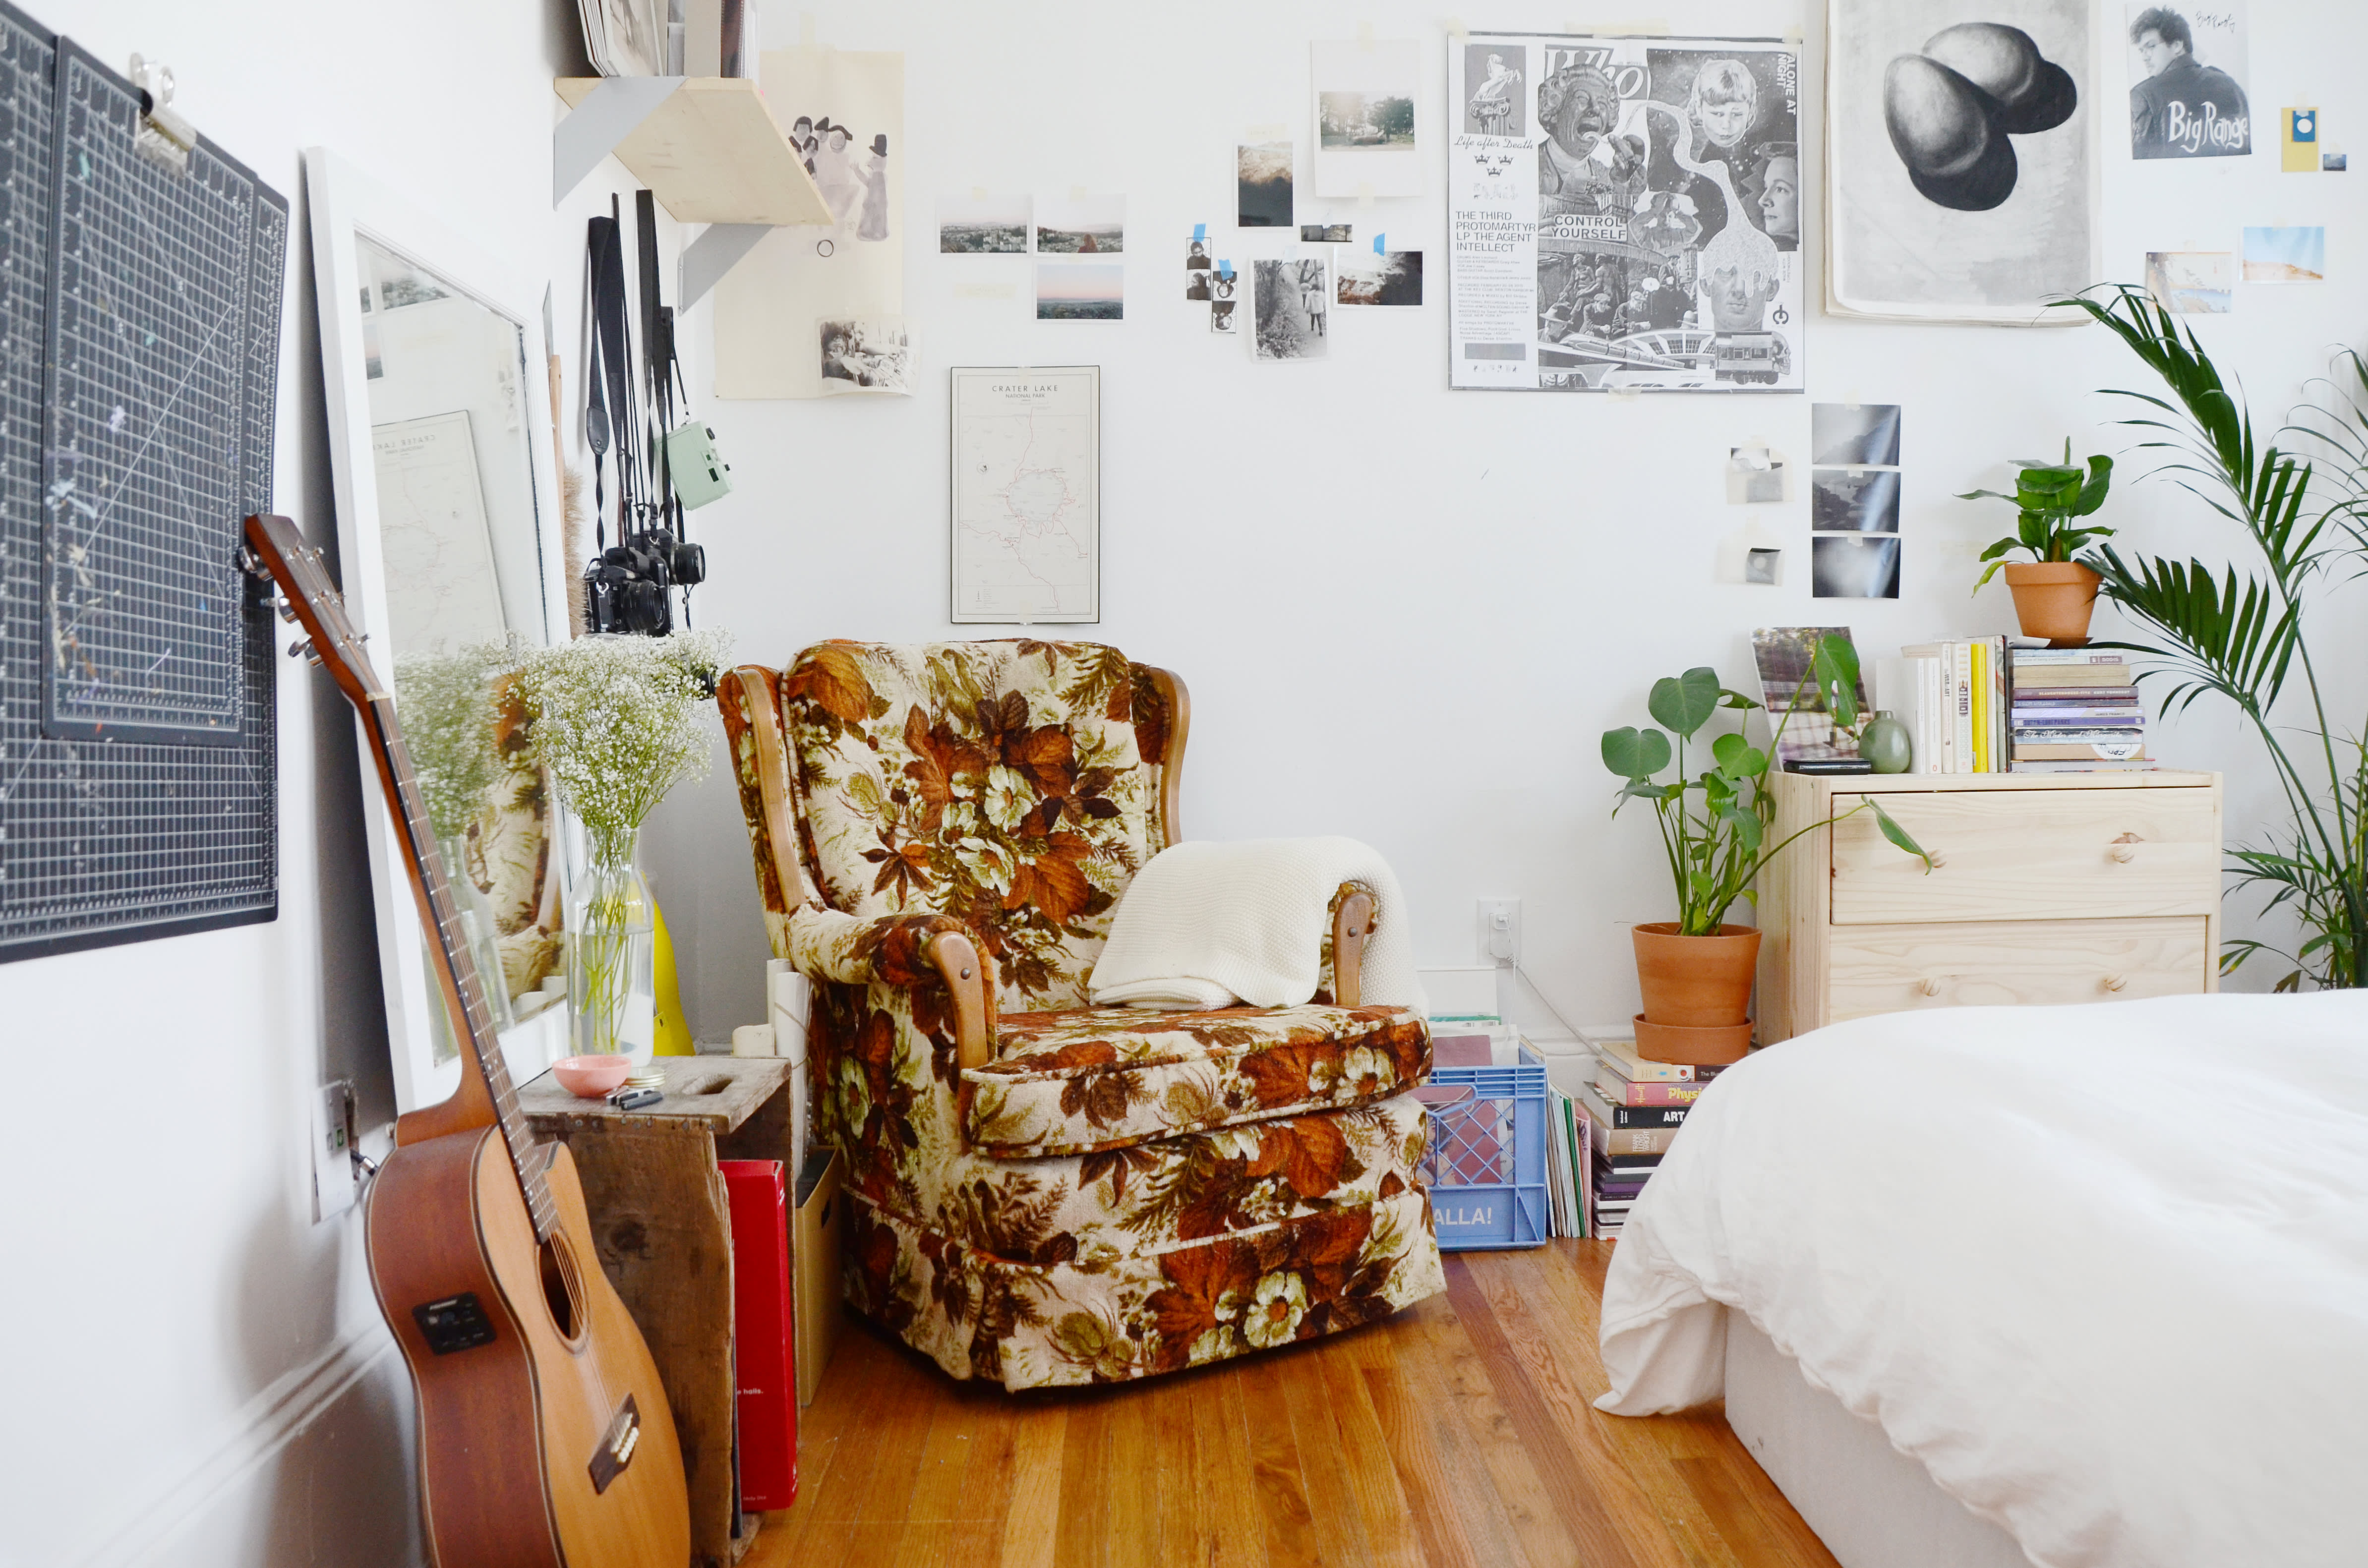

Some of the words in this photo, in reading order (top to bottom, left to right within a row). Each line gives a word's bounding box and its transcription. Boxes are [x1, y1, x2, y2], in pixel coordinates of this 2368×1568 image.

[1776, 54, 1788, 89] NIGHT
[1785, 55, 1796, 96] ALONE
[1786, 99, 1796, 116] AT
[2168, 101, 2202, 153] Big
[2201, 101, 2249, 150] Range
[1454, 135, 1475, 150] Life
[1477, 137, 1500, 150] after
[1503, 138, 1534, 149] Death
[1456, 211, 1476, 220] THE
[1480, 211, 1512, 220] THIRD
[1456, 222, 1536, 232] PROTOMARTYR
[1554, 216, 1623, 227] CONTROL
[1456, 232, 1470, 240] LP
[1474, 232, 1494, 241] THE
[1496, 232, 1532, 242] AGENT
[1551, 228, 1626, 239] YOURSELF
[1457, 242, 1515, 252] INTELLECT
[1663, 1111, 1685, 1122] ART
[1433, 1207, 1492, 1225] ALLA!
